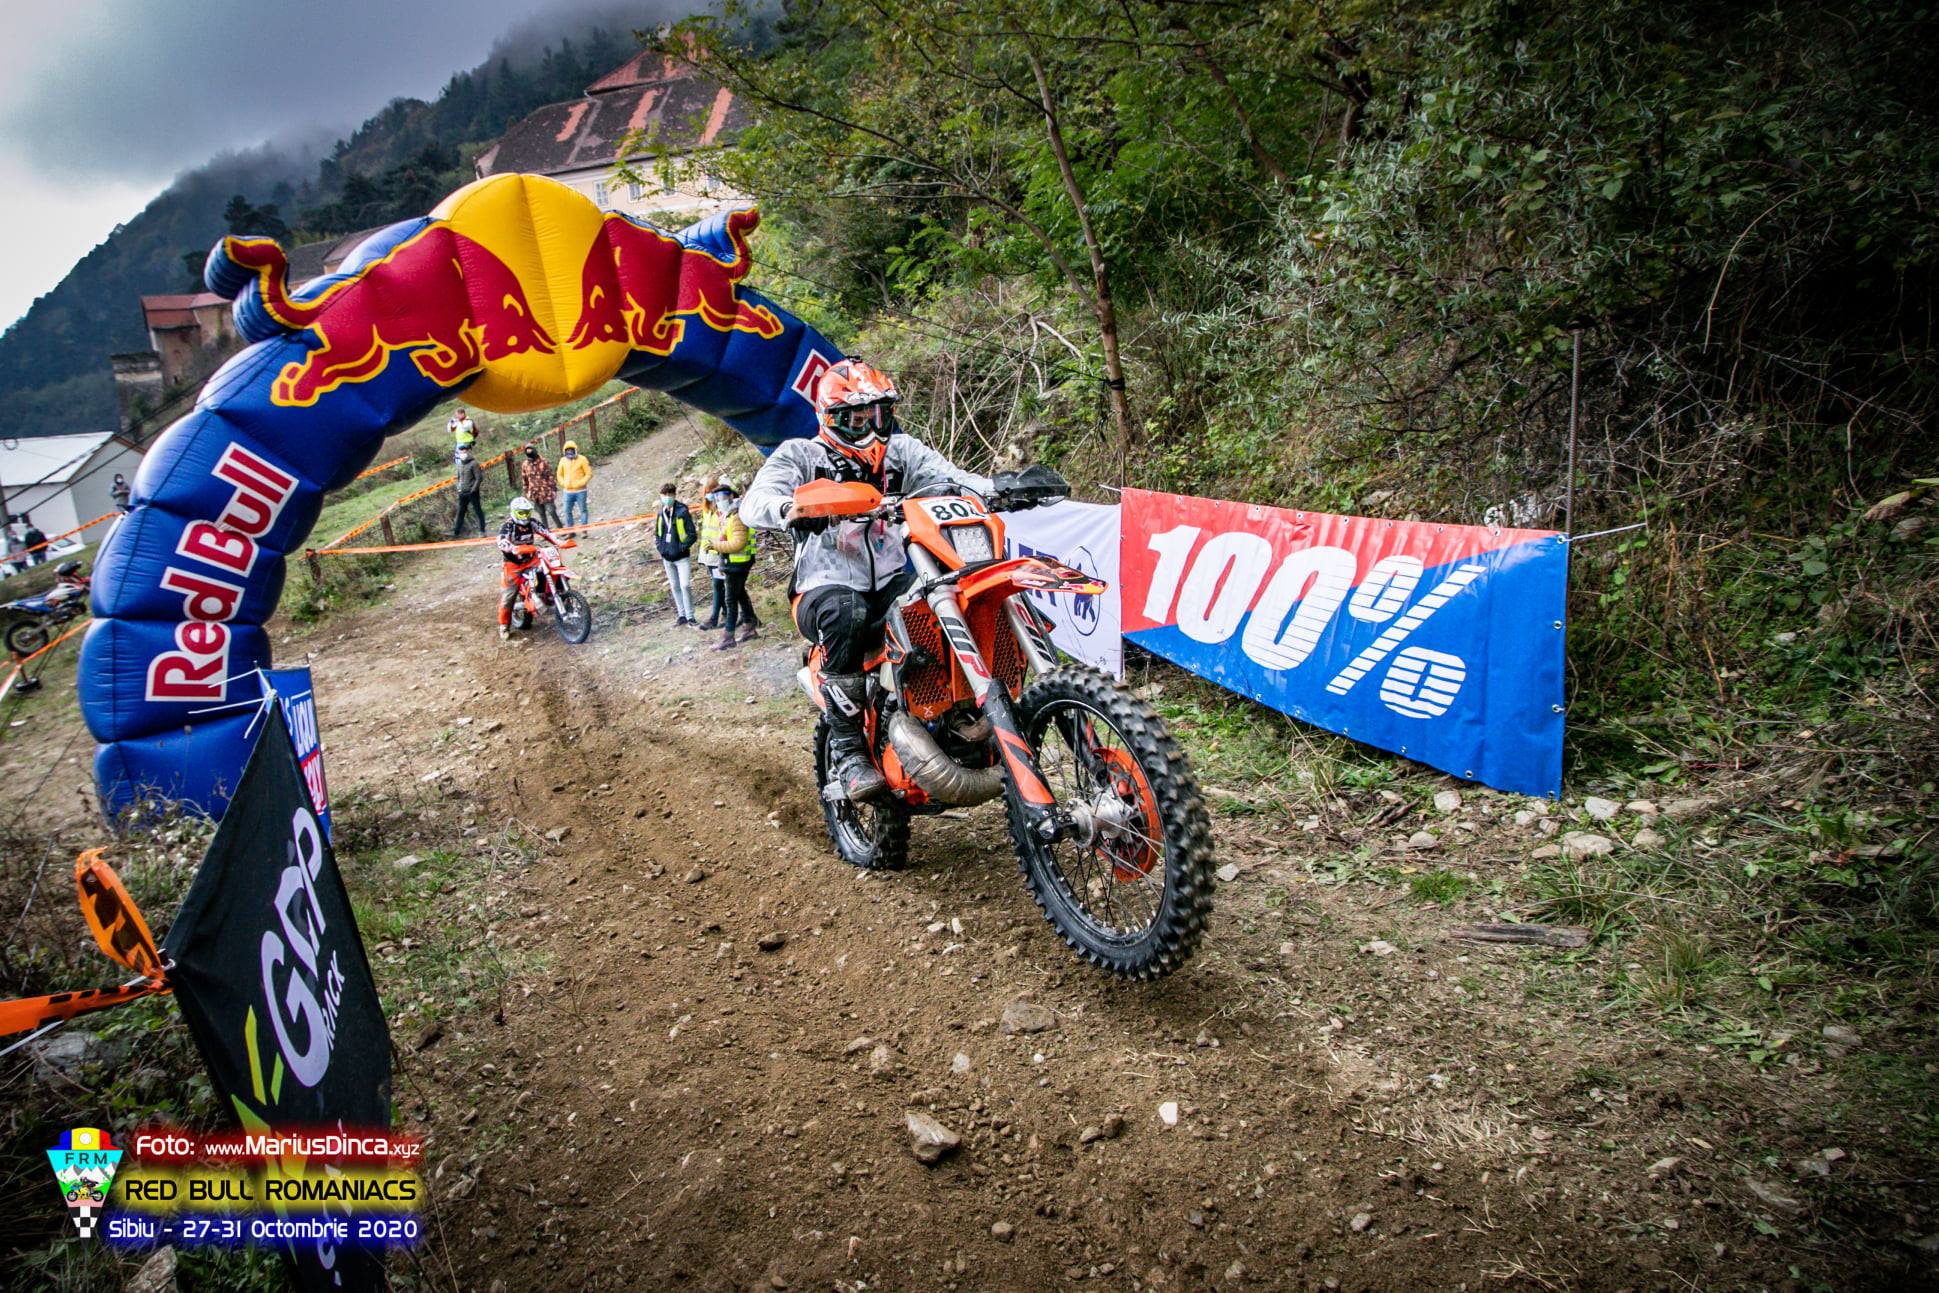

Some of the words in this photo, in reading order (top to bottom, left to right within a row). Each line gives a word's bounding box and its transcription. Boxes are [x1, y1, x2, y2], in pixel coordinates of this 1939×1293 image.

[177, 442, 298, 576] Bull
[146, 567, 244, 700] Red
[1142, 524, 1486, 719] 100%
